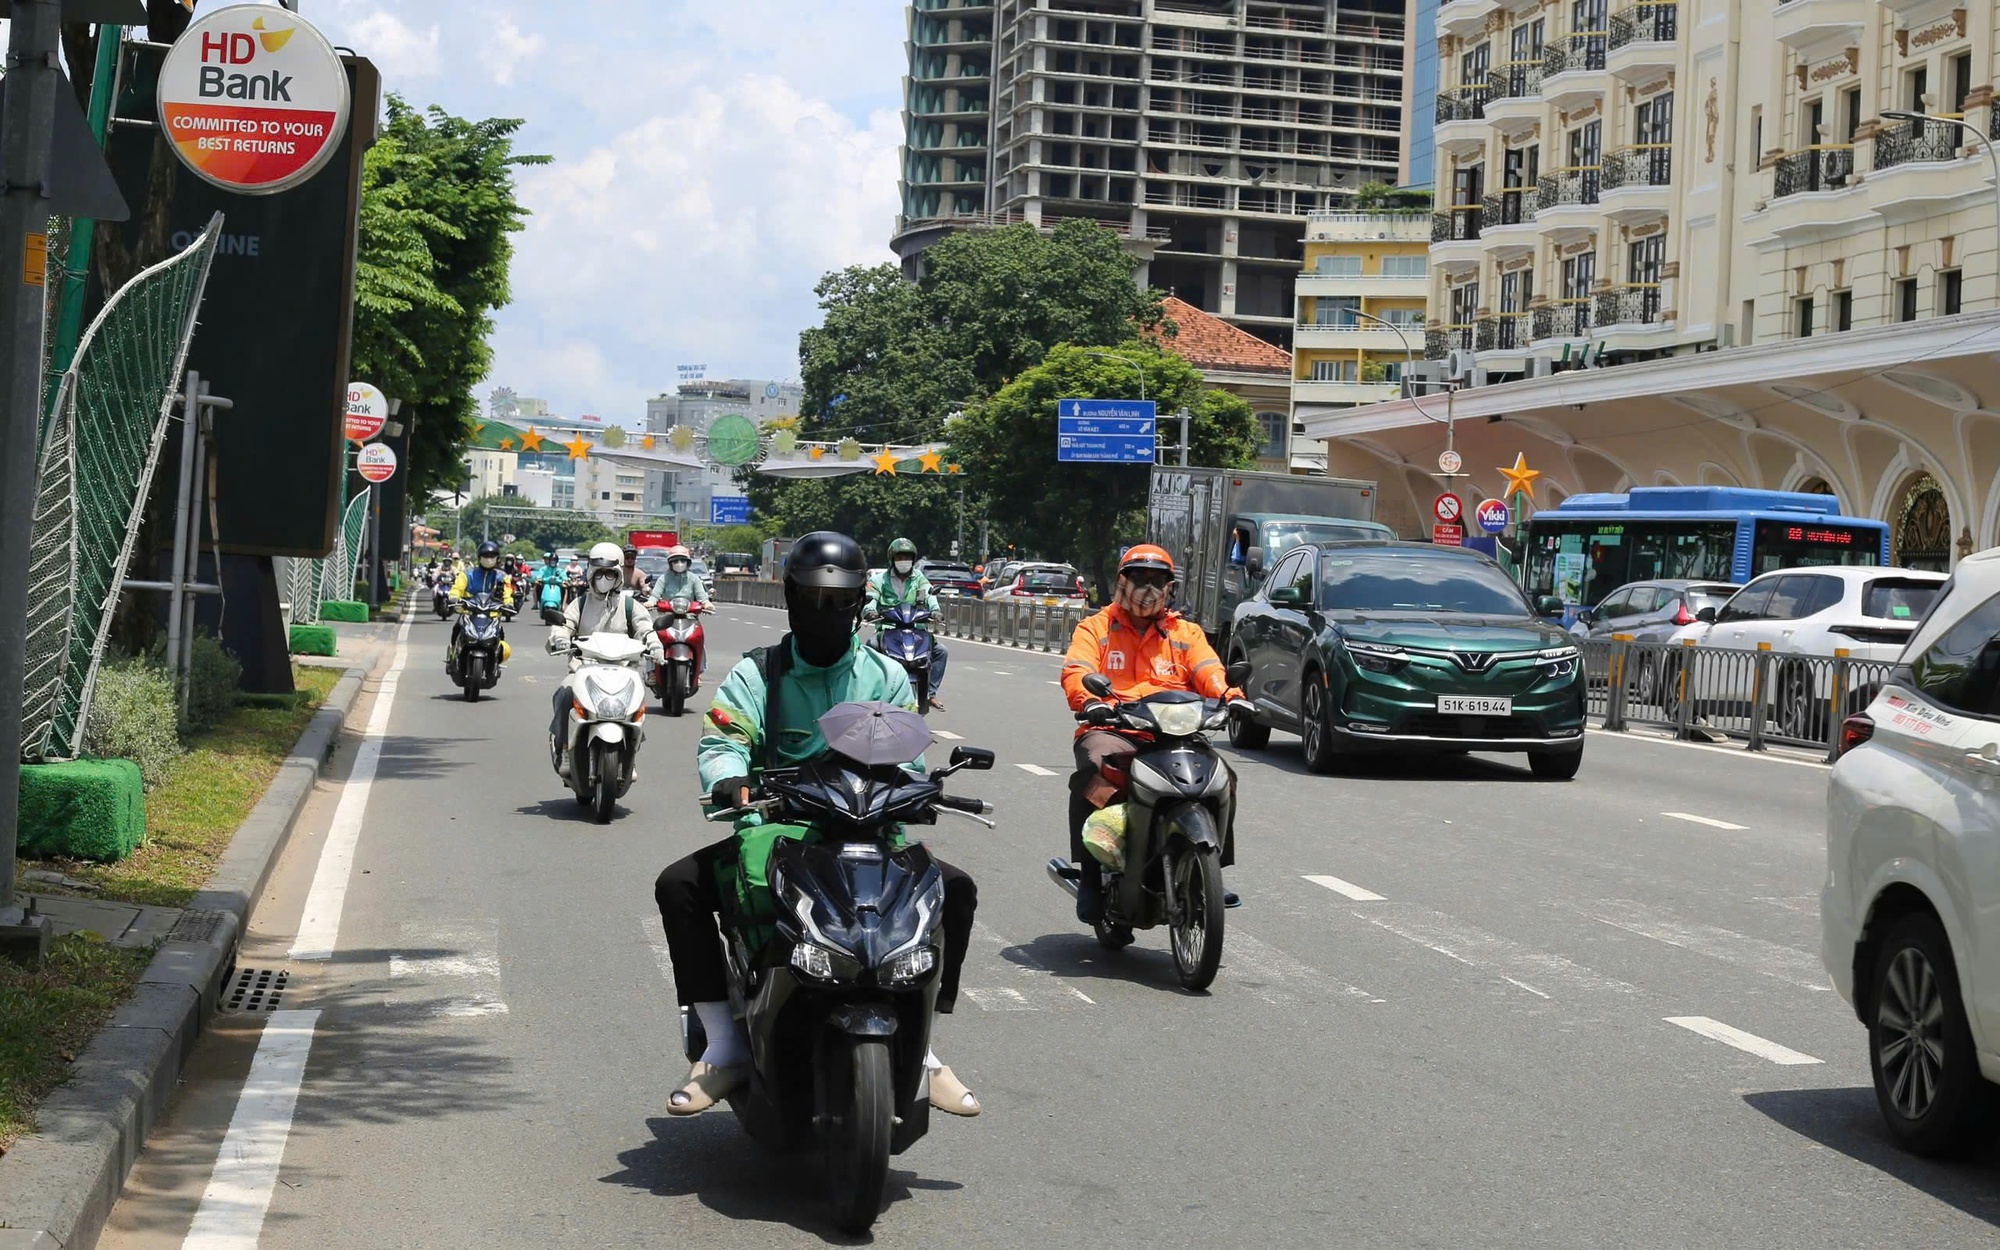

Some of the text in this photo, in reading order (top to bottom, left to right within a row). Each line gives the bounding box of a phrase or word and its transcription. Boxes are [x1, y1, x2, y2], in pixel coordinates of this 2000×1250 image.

[201, 31, 255, 65] HD
[199, 66, 293, 102] Bank
[173, 116, 323, 136] COMMITTED TO YOUR
[198, 137, 295, 155] BEST RETURNS
[1480, 505, 1505, 521] Vikki
[1444, 700, 1506, 712] 51K-619.44
